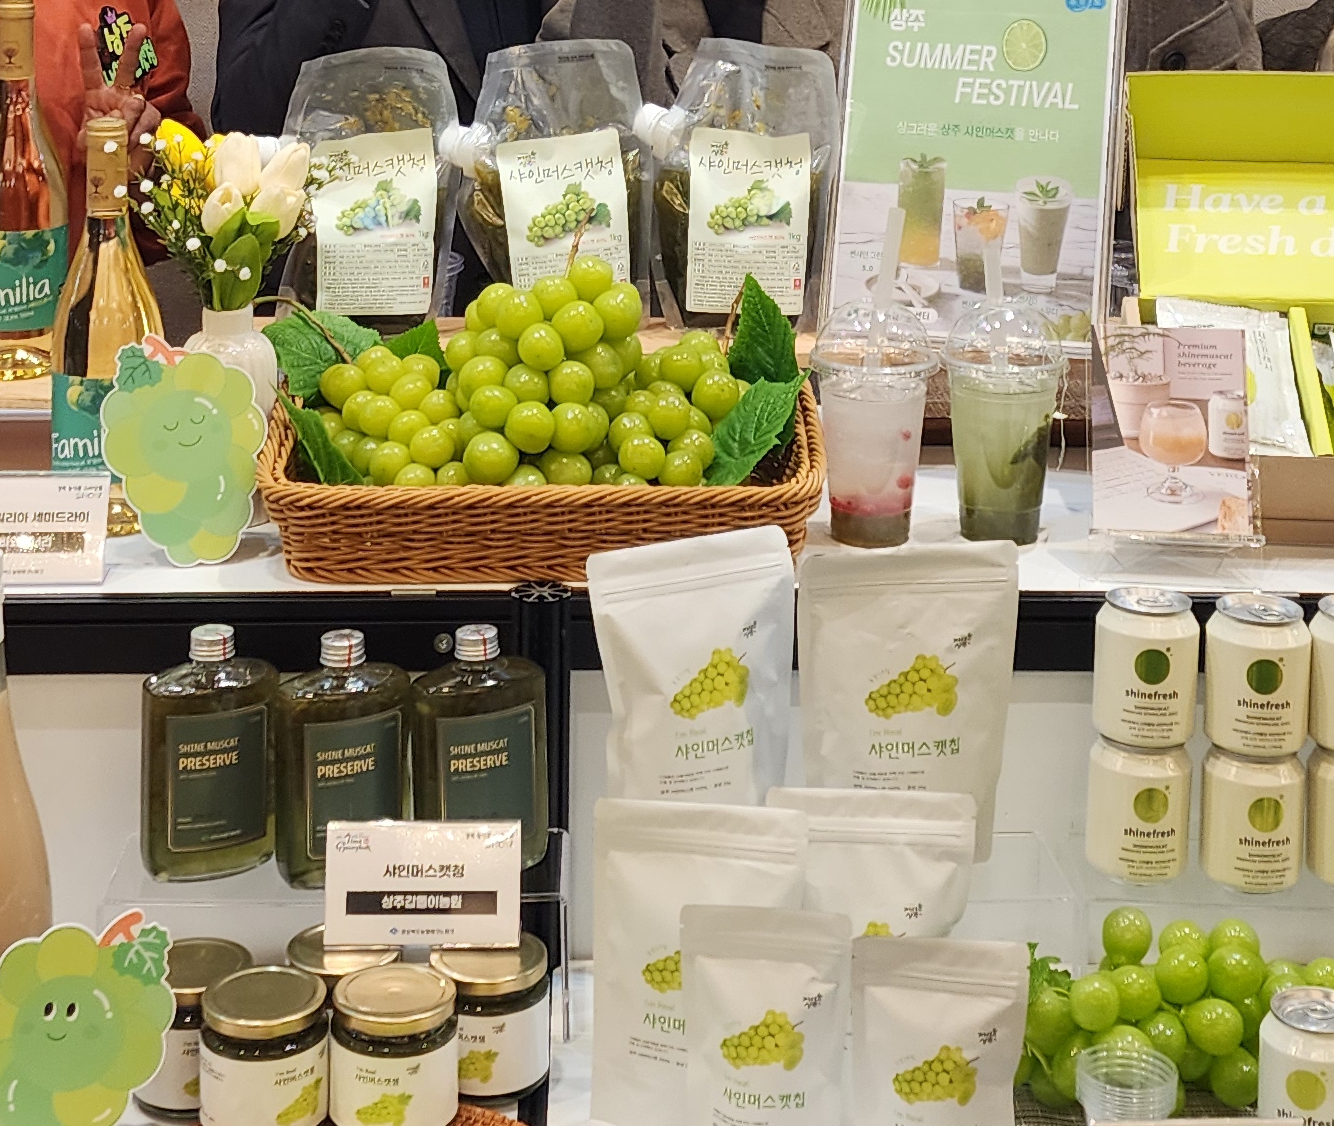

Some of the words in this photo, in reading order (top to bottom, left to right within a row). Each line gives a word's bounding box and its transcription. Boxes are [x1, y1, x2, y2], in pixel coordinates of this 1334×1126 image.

[888, 8, 926, 32] 상주
[885, 40, 998, 73] SUMMER
[953, 76, 1080, 110] FESTIVAL
[1163, 183, 1285, 214] Have
[1297, 192, 1329, 217] a
[788, 232, 802, 243] 1kg
[1163, 223, 1299, 258] Fresh
[1177, 342, 1218, 351] Premium
[1177, 360, 1218, 370] beverage
[51, 429, 100, 460] Fami
[31, 510, 90, 524] 세미드라이
[1124, 688, 1179, 701] shinefresh
[1236, 697, 1291, 711] shinefresh
[178, 741, 207, 755] SHINE
[207, 736, 240, 751] MUSCAT
[316, 749, 343, 762] SHINE
[344, 742, 376, 758] MUSCAT
[449, 742, 476, 756] SHINE
[477, 737, 509, 752] MUSCAT
[178, 750, 240, 771] PRESERVE
[316, 756, 376, 779] PRESERVE
[449, 751, 509, 773] PRESERVE
[1123, 826, 1177, 839] shinefresh
[1238, 836, 1291, 848] shinefresh
[643, 1012, 686, 1036] 샤인머
